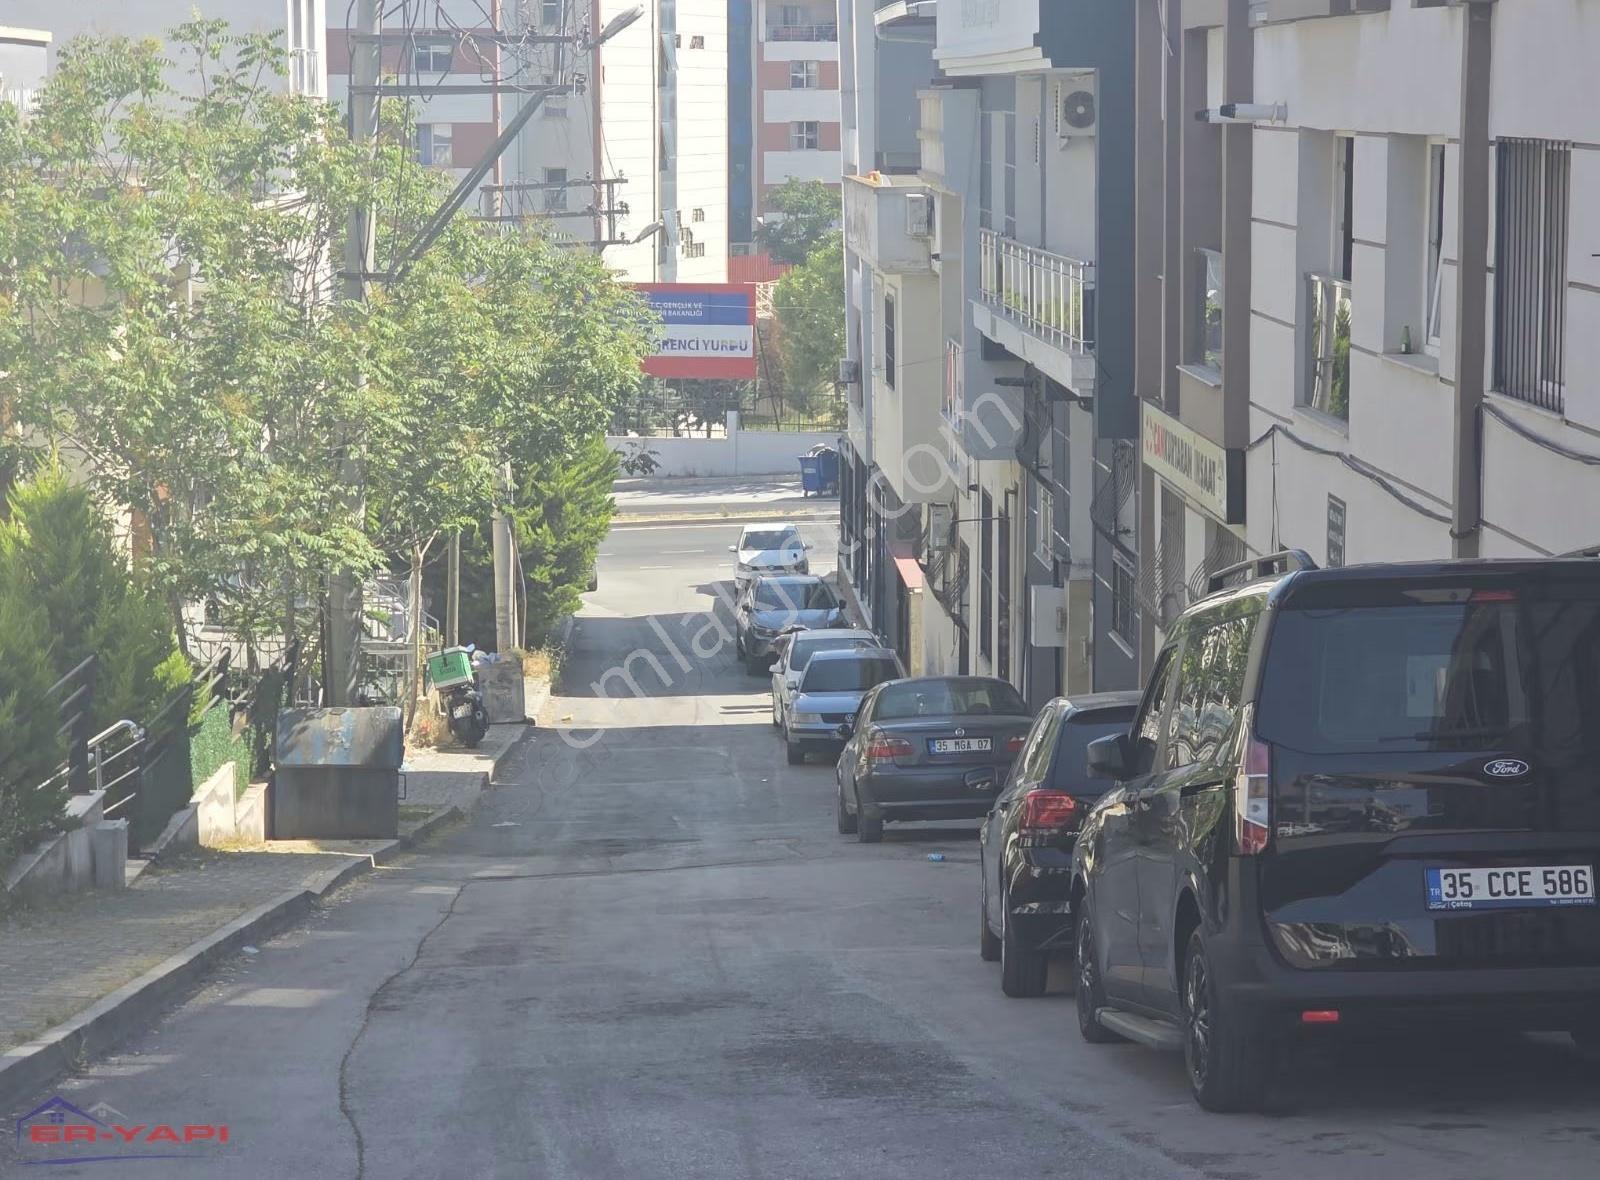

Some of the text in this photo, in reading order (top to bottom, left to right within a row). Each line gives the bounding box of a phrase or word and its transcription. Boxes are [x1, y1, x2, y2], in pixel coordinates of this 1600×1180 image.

[936, 741, 948, 751] 35
[978, 740, 989, 749] 07
[1492, 761, 1520, 774] Ford
[1430, 869, 1588, 898] TR 35 CCE 586
